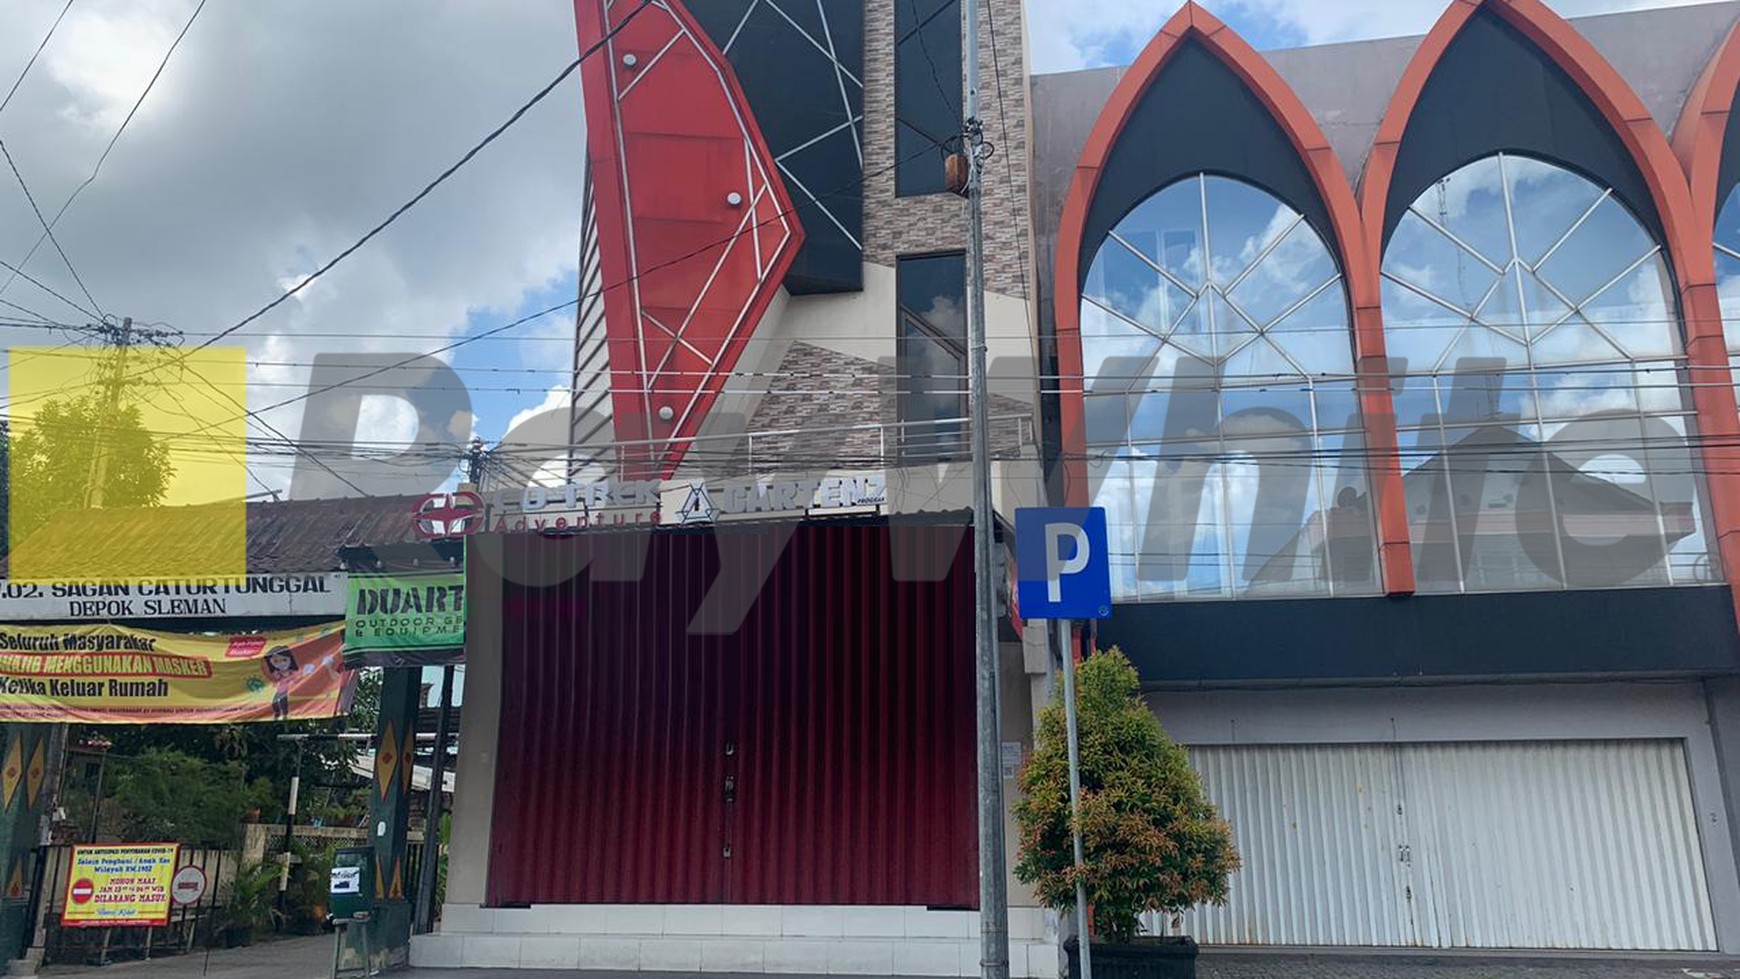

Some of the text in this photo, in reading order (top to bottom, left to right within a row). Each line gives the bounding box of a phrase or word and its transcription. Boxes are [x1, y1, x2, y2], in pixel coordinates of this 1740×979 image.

[724, 475, 886, 514] CARTENZ
[493, 509, 662, 534] Adventure
[1045, 522, 1090, 603] P
[0, 581, 43, 598] .02.
[51, 579, 130, 598] SAGAN
[69, 598, 226, 617] DEPOK SLEMAN
[355, 617, 435, 629] OUTDOOR
[374, 625, 461, 637] EQUIPME
[0, 632, 60, 651] Seluruh
[43, 654, 152, 674] MENGGUNAKAN
[153, 656, 207, 676] MASKER
[50, 678, 105, 697] Keluar
[108, 679, 169, 697] Rumah
[94, 893, 167, 903] DILARANG MASUK
